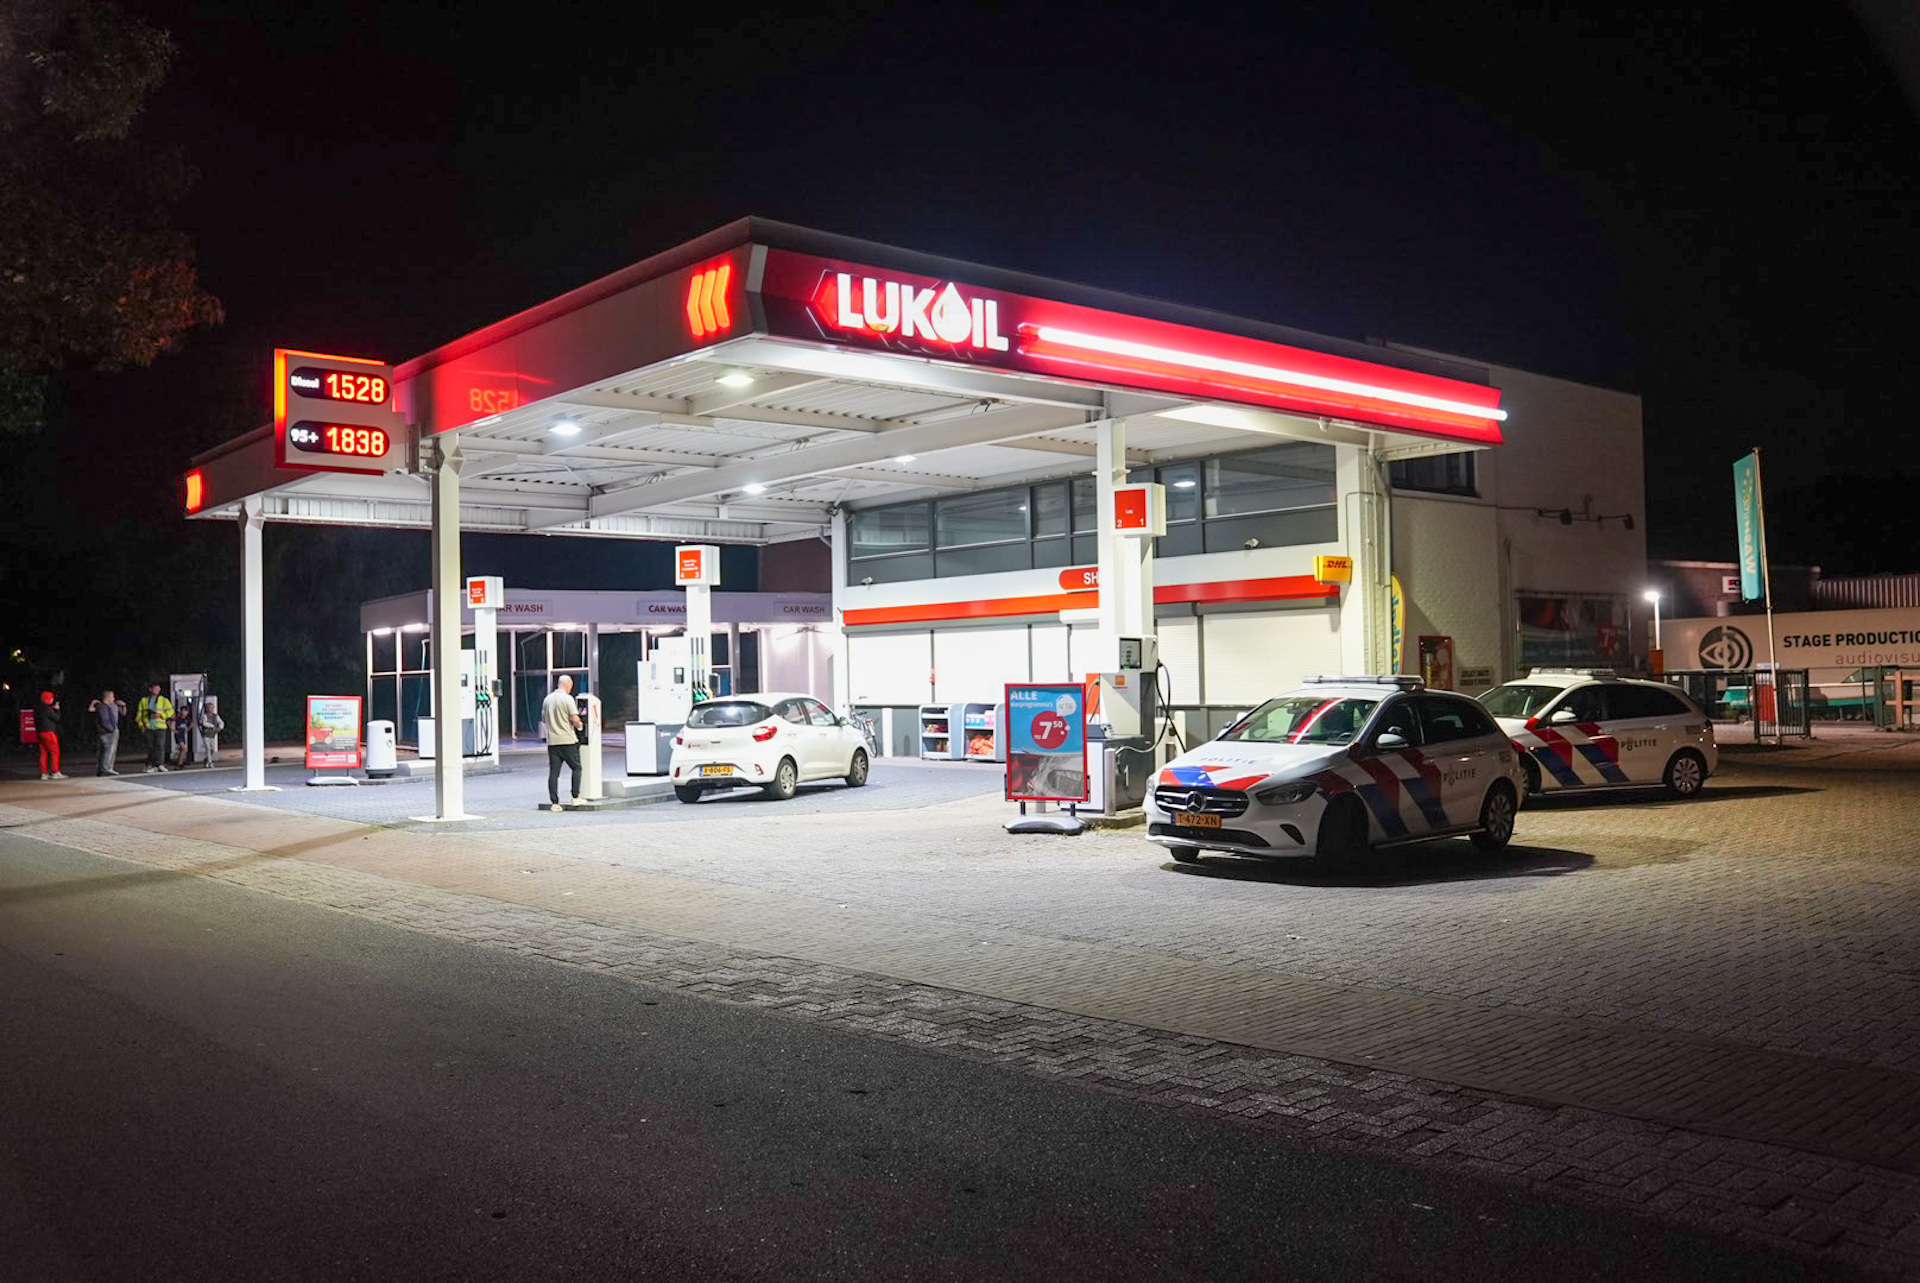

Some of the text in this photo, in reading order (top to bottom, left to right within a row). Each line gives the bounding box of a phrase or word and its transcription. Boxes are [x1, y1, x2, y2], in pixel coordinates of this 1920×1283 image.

[837, 272, 1009, 352] LUKOIL
[1117, 519, 1123, 527] 2
[1326, 560, 1349, 569] DHL
[514, 604, 544, 613] WASH
[648, 605, 666, 613] CAR
[783, 605, 825, 614] CAR WASH
[1783, 634, 1832, 648] STAGE
[1010, 691, 1038, 700] ALLE
[1620, 739, 1657, 751] POLITIE
[1443, 768, 1476, 786] POLITIE
